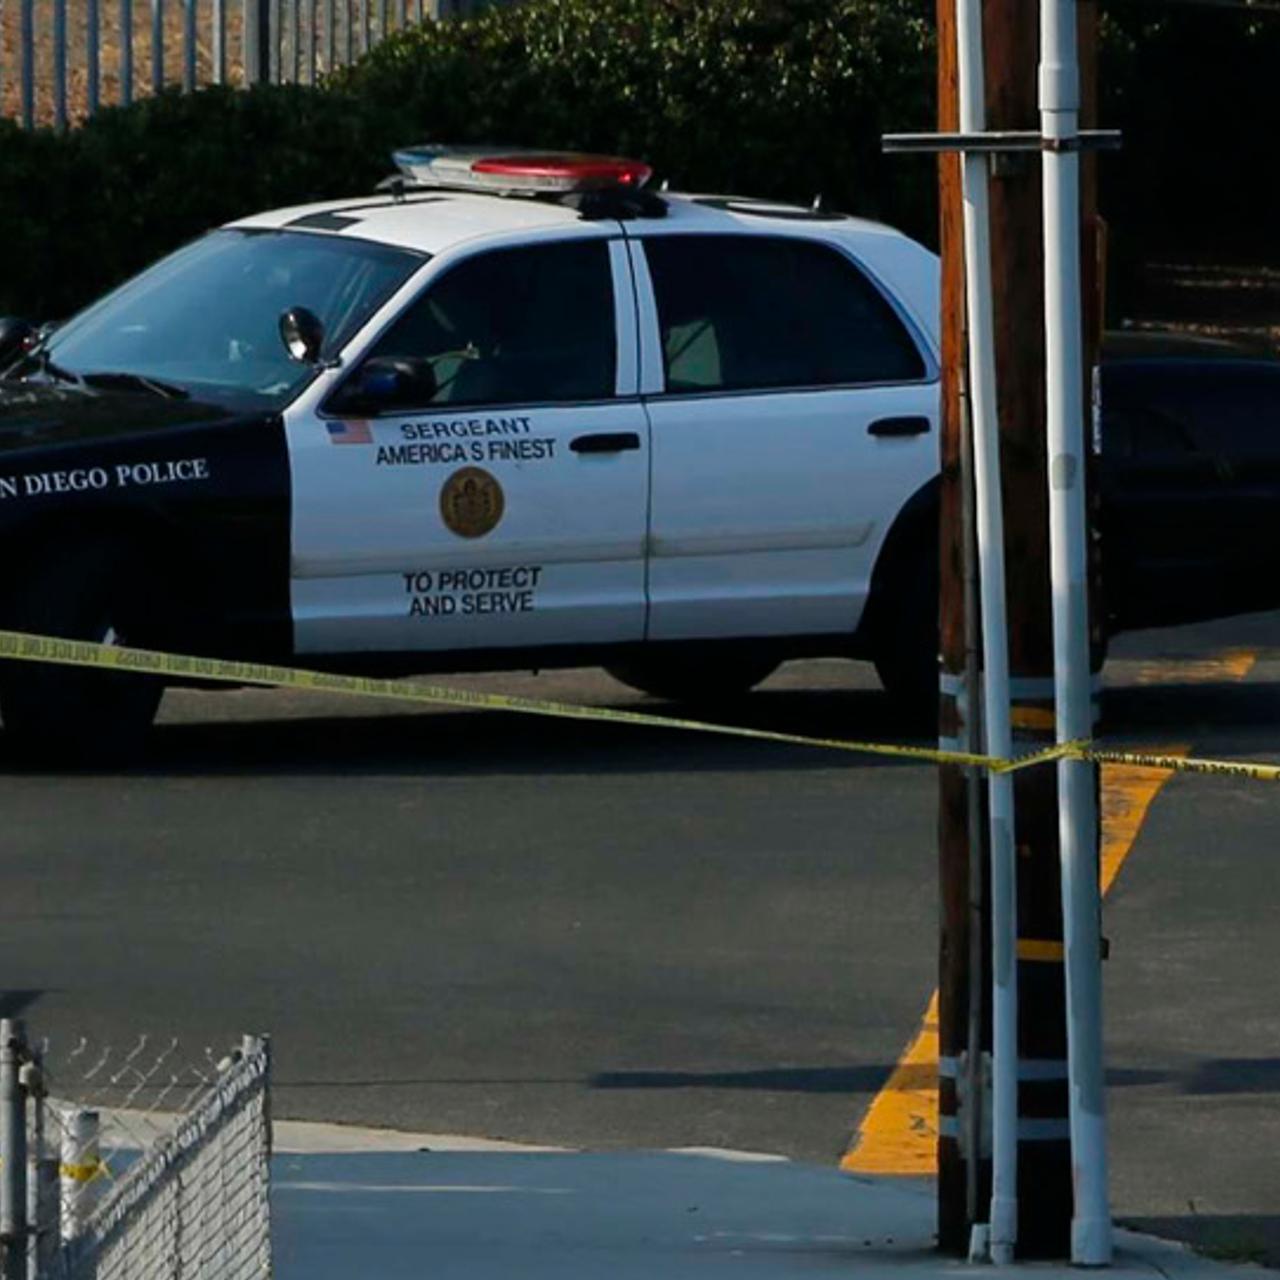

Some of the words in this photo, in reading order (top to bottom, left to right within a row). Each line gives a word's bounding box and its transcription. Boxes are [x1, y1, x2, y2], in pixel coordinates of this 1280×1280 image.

[401, 417, 531, 441] SERGEANT
[488, 438, 556, 461] FINEST
[24, 466, 108, 494] DIEGO
[116, 459, 209, 487] POLICE
[404, 572, 433, 594] TO
[439, 567, 541, 591] PROTECT
[409, 597, 456, 616] AND
[462, 593, 534, 614] SERVE
